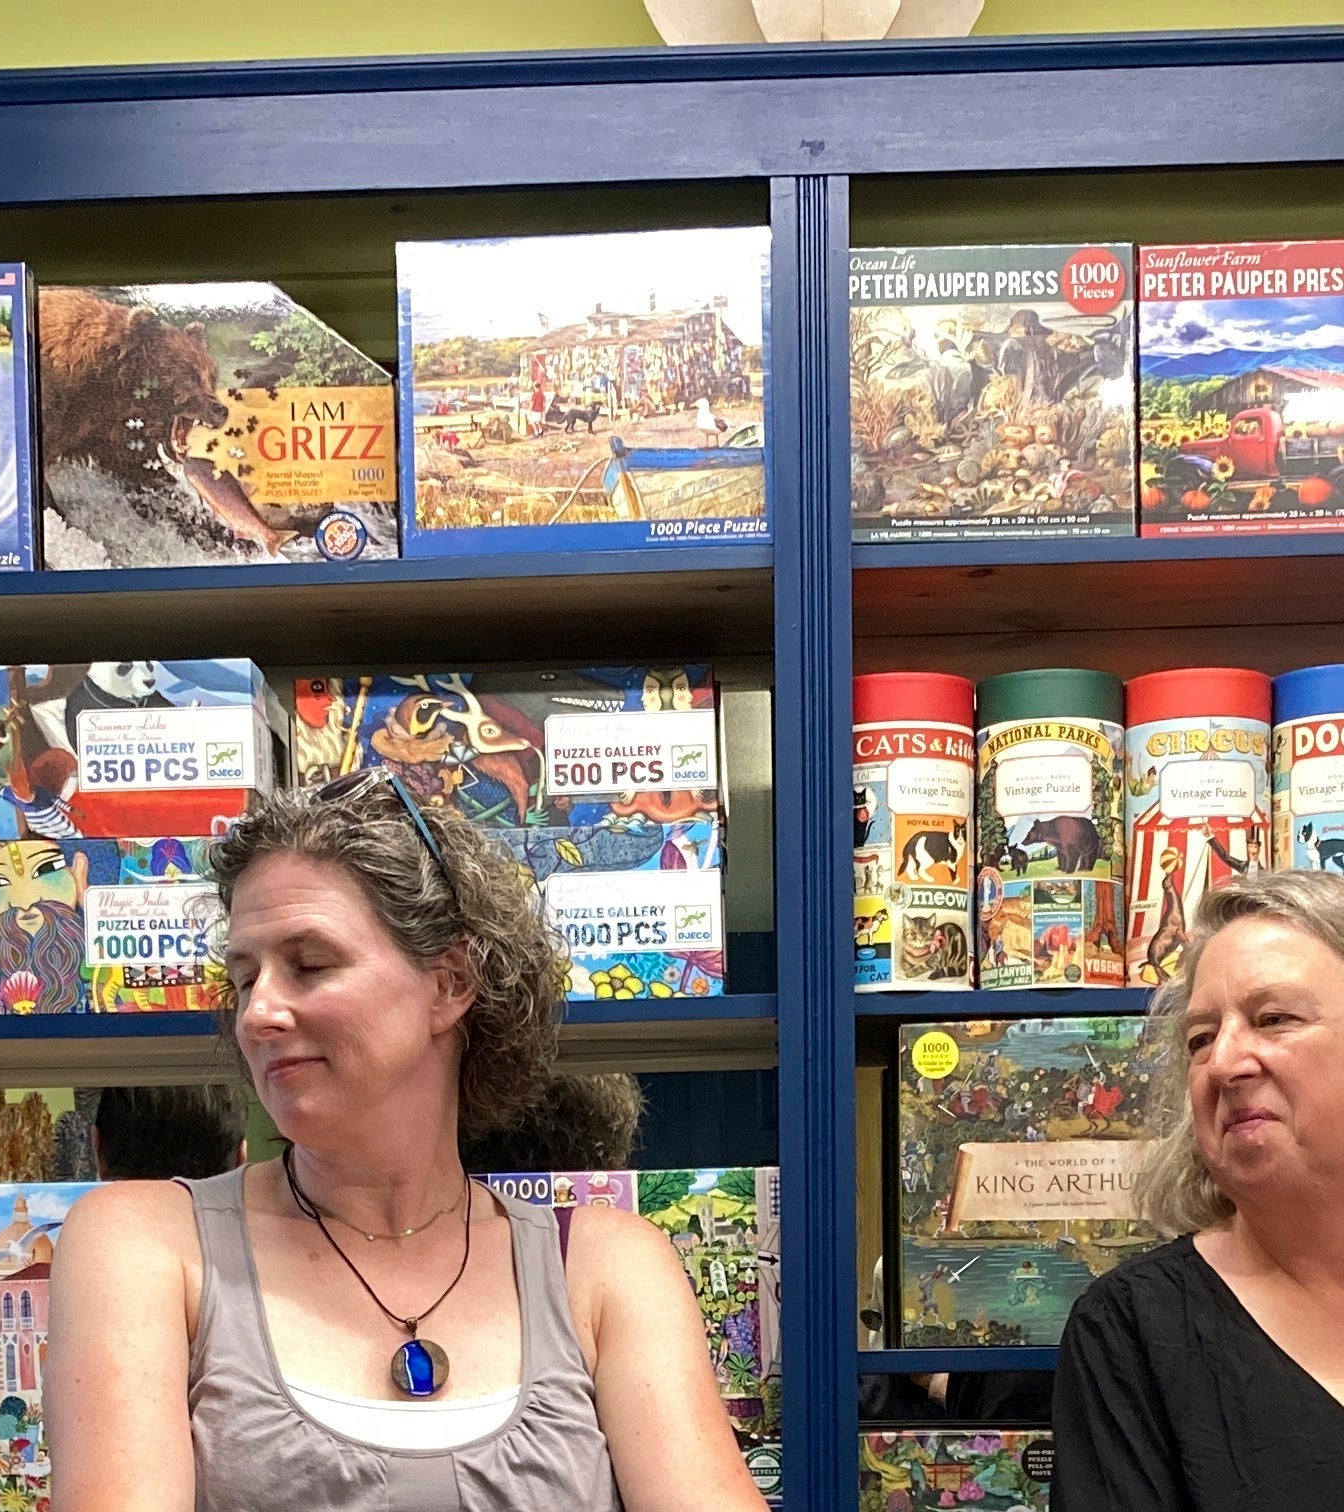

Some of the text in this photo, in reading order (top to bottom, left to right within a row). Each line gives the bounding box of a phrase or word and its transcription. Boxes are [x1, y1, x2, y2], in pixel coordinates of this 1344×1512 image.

[850, 255, 916, 273] Ocean Life
[1146, 251, 1260, 271] Sunflower Farm
[1069, 262, 1119, 285] 1000
[849, 270, 1059, 300] PETER PAUPER PRESS
[1073, 284, 1115, 299] Pieces
[1144, 272, 1205, 298] PETER
[1211, 269, 1287, 296] PAUPER
[291, 401, 345, 421] I AM
[257, 425, 385, 462] GRIZZ
[685, 518, 767, 534] Piece Puzzle
[84, 714, 167, 732] Summer Lake
[86, 742, 195, 756] PUZZLE GALLERY
[856, 734, 942, 757] CATS &
[988, 725, 1101, 755] NATIONAL PARKS
[1146, 729, 1265, 757] CIRCUS
[554, 745, 661, 759] PUZZLE GALLERY
[87, 758, 199, 783] 350 PCS
[209, 769, 241, 777] DJECO
[554, 761, 664, 786] 500 PCS
[675, 771, 706, 779] DJECO
[1005, 783, 1081, 797] Vintage Puzzle
[1171, 788, 1248, 800] Vintage Puzzle
[1299, 785, 1337, 796] Vintage
[98, 889, 169, 911] Magic India
[912, 890, 968, 908] meow
[557, 905, 666, 919] PUZZLE GALLERY
[97, 919, 146, 931] PUZZLE
[617, 921, 668, 945] PCS
[678, 932, 711, 940] DJECO
[869, 972, 890, 981] CAT
[999, 965, 1032, 978] CANYON
[923, 1042, 950, 1053] 1000
[1025, 1158, 1105, 1167] THE WORLD OF
[976, 1175, 1034, 1194] KING
